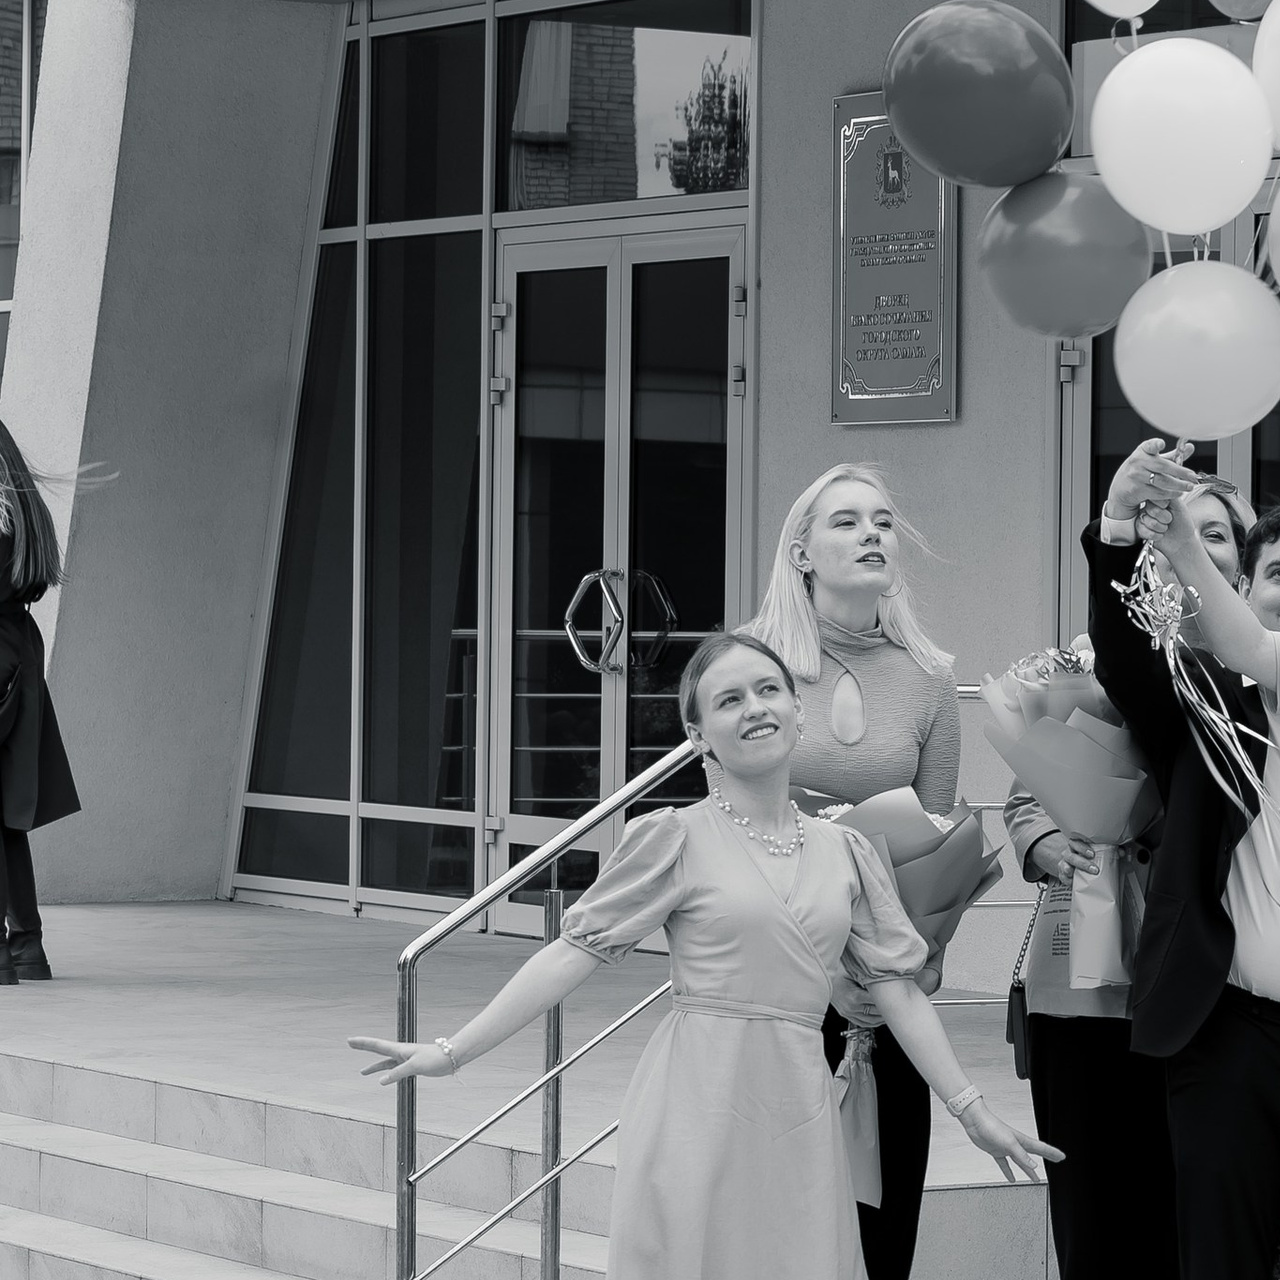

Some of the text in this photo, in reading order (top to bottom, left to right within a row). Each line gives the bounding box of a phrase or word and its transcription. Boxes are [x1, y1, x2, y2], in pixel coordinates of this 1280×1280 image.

[874, 294, 909, 310] ДВОРЕЦ
[850, 310, 933, 327] БРАКОСОЧЕТАНИЯ
[862, 329, 921, 345] ГОРОДСКОГО
[856, 346, 926, 362] ОКРУГА САМАРА
